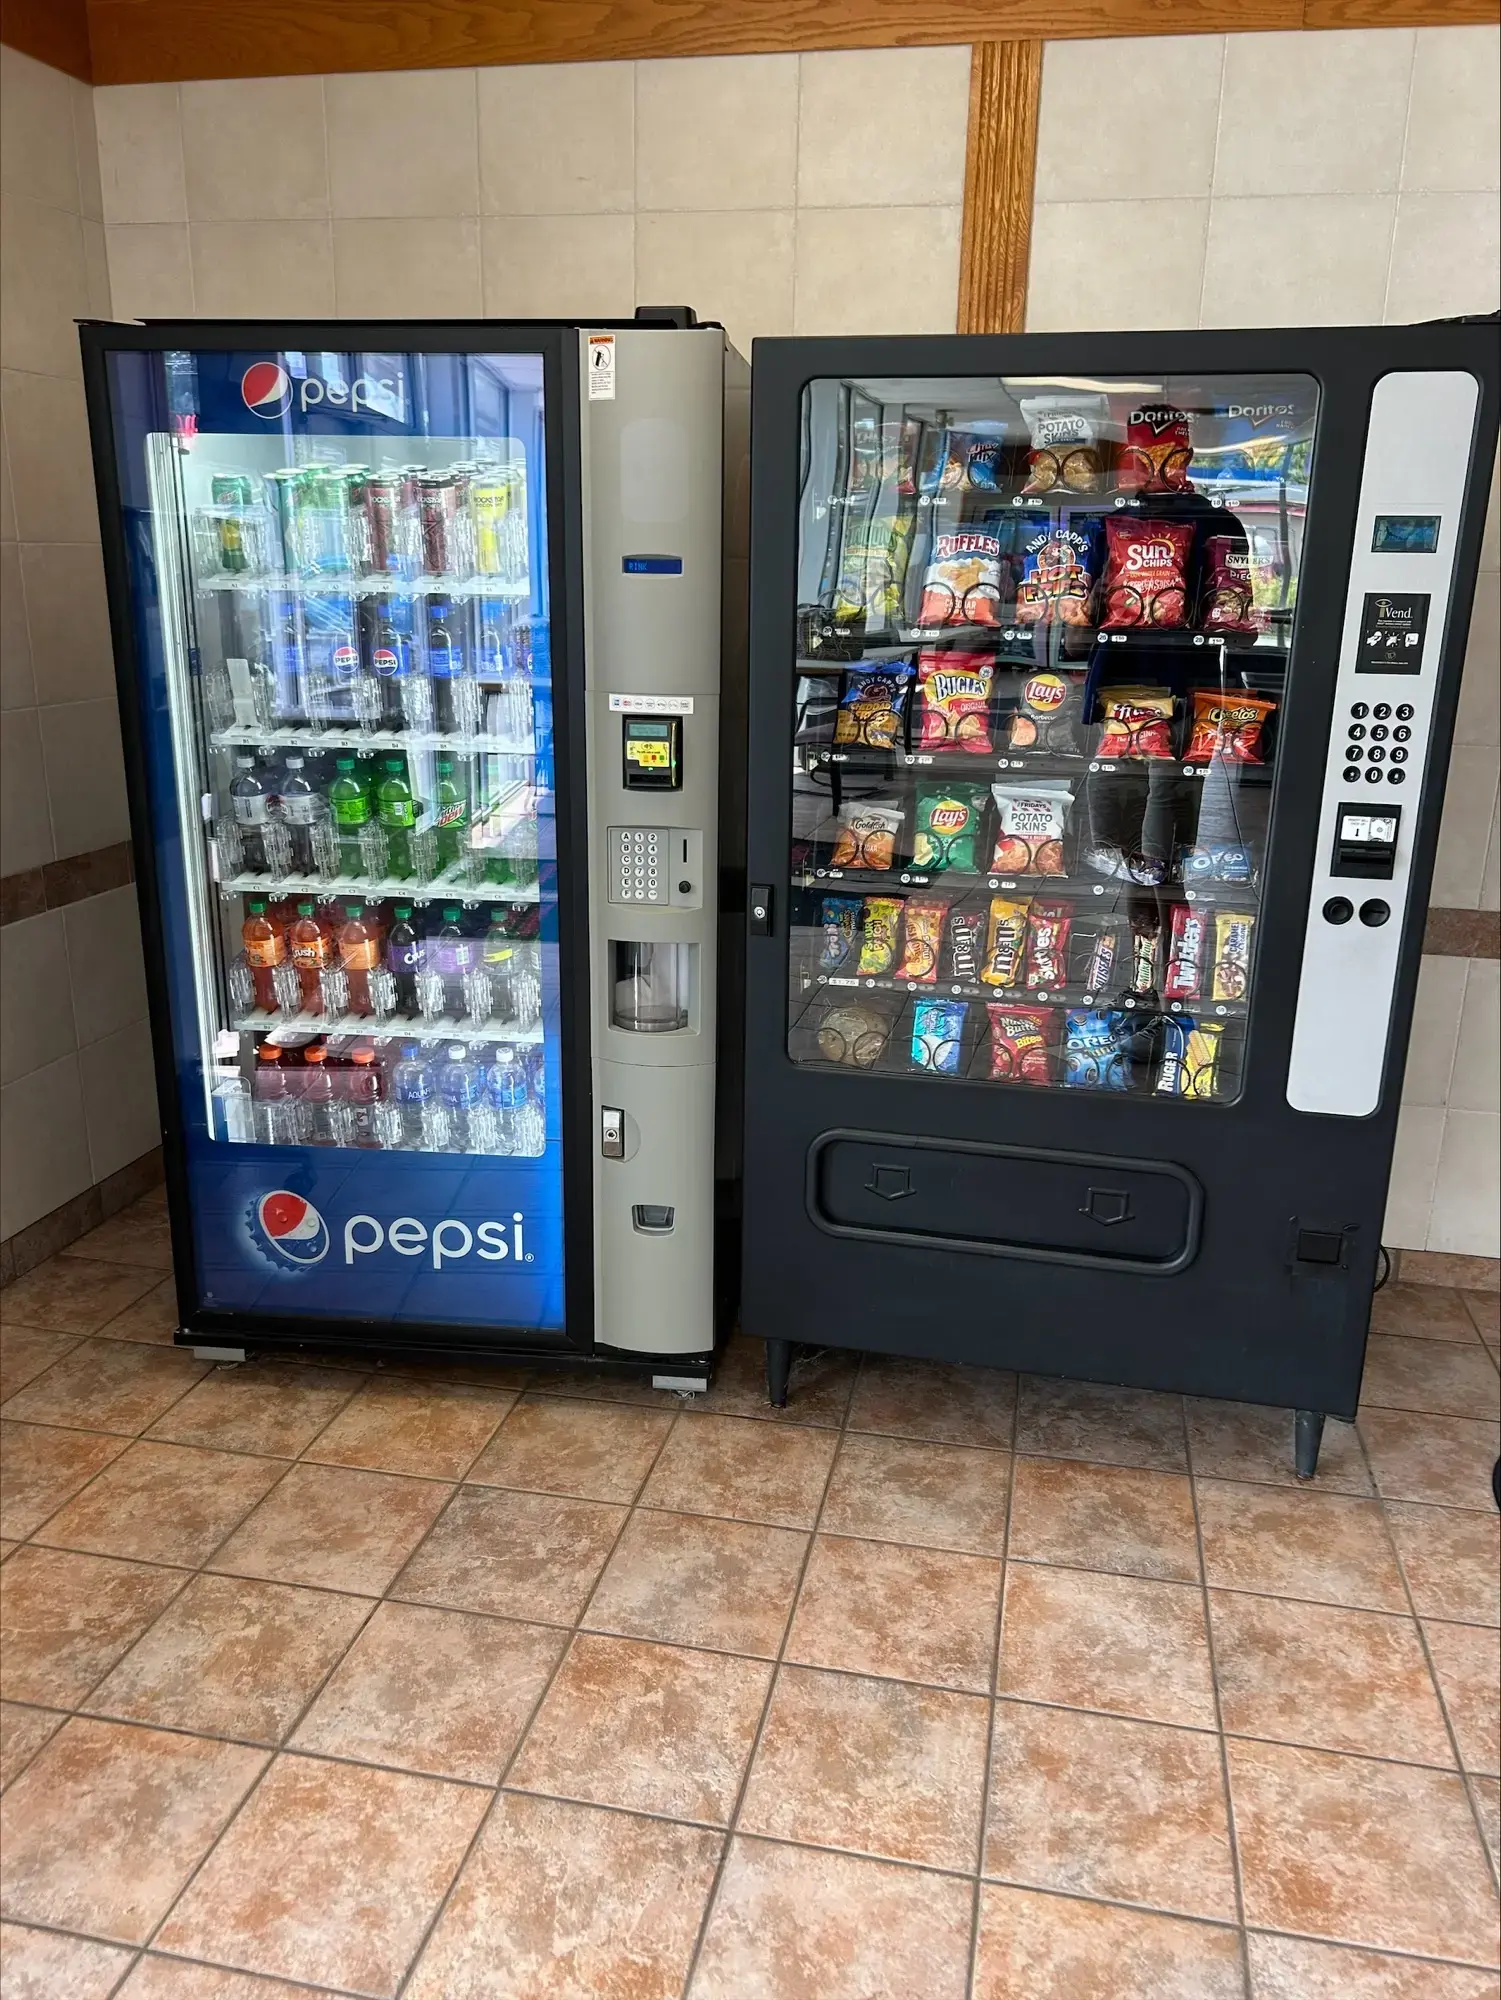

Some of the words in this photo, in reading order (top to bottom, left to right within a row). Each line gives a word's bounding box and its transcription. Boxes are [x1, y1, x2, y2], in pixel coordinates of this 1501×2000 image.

[300, 371, 404, 413] pepsi
[1130, 410, 1194, 425] Doritos
[1229, 404, 1294, 418] Doritos
[1038, 419, 1085, 434] POTATO
[1044, 429, 1080, 445] SKINS
[936, 533, 1000, 558] RUFFLES
[1055, 529, 1089, 553] CAPP'S
[1126, 538, 1176, 571] Sun
[1142, 559, 1173, 568] CHIPS
[1030, 564, 1083, 584] HOT
[334, 654, 358, 664] PEPSI
[374, 658, 397, 666] PEPSI
[934, 672, 987, 702] BUGLES
[1210, 707, 1257, 722] Cheetos
[1358, 705, 1363, 716] 1
[1379, 706, 1387, 717] 2
[1401, 706, 1409, 717] 3
[1353, 727, 1361, 738] 4
[1376, 727, 1384, 739] 5
[1398, 728, 1406, 739] 6
[1352, 748, 1359, 759] 7
[1373, 749, 1380, 760] 8
[1395, 749, 1403, 760] 9
[1370, 770, 1378, 780] 0
[854, 819, 886, 830] Goldfish
[1011, 812, 1053, 823] POTATO
[1014, 822, 1048, 832] SKINS
[1033, 927, 1056, 980] Skittles
[1016, 1034, 1043, 1049] Bites
[1066, 1034, 1117, 1050] OREO
[1157, 1051, 1179, 1092] RUGER
[343, 1211, 524, 1271] pepsi
